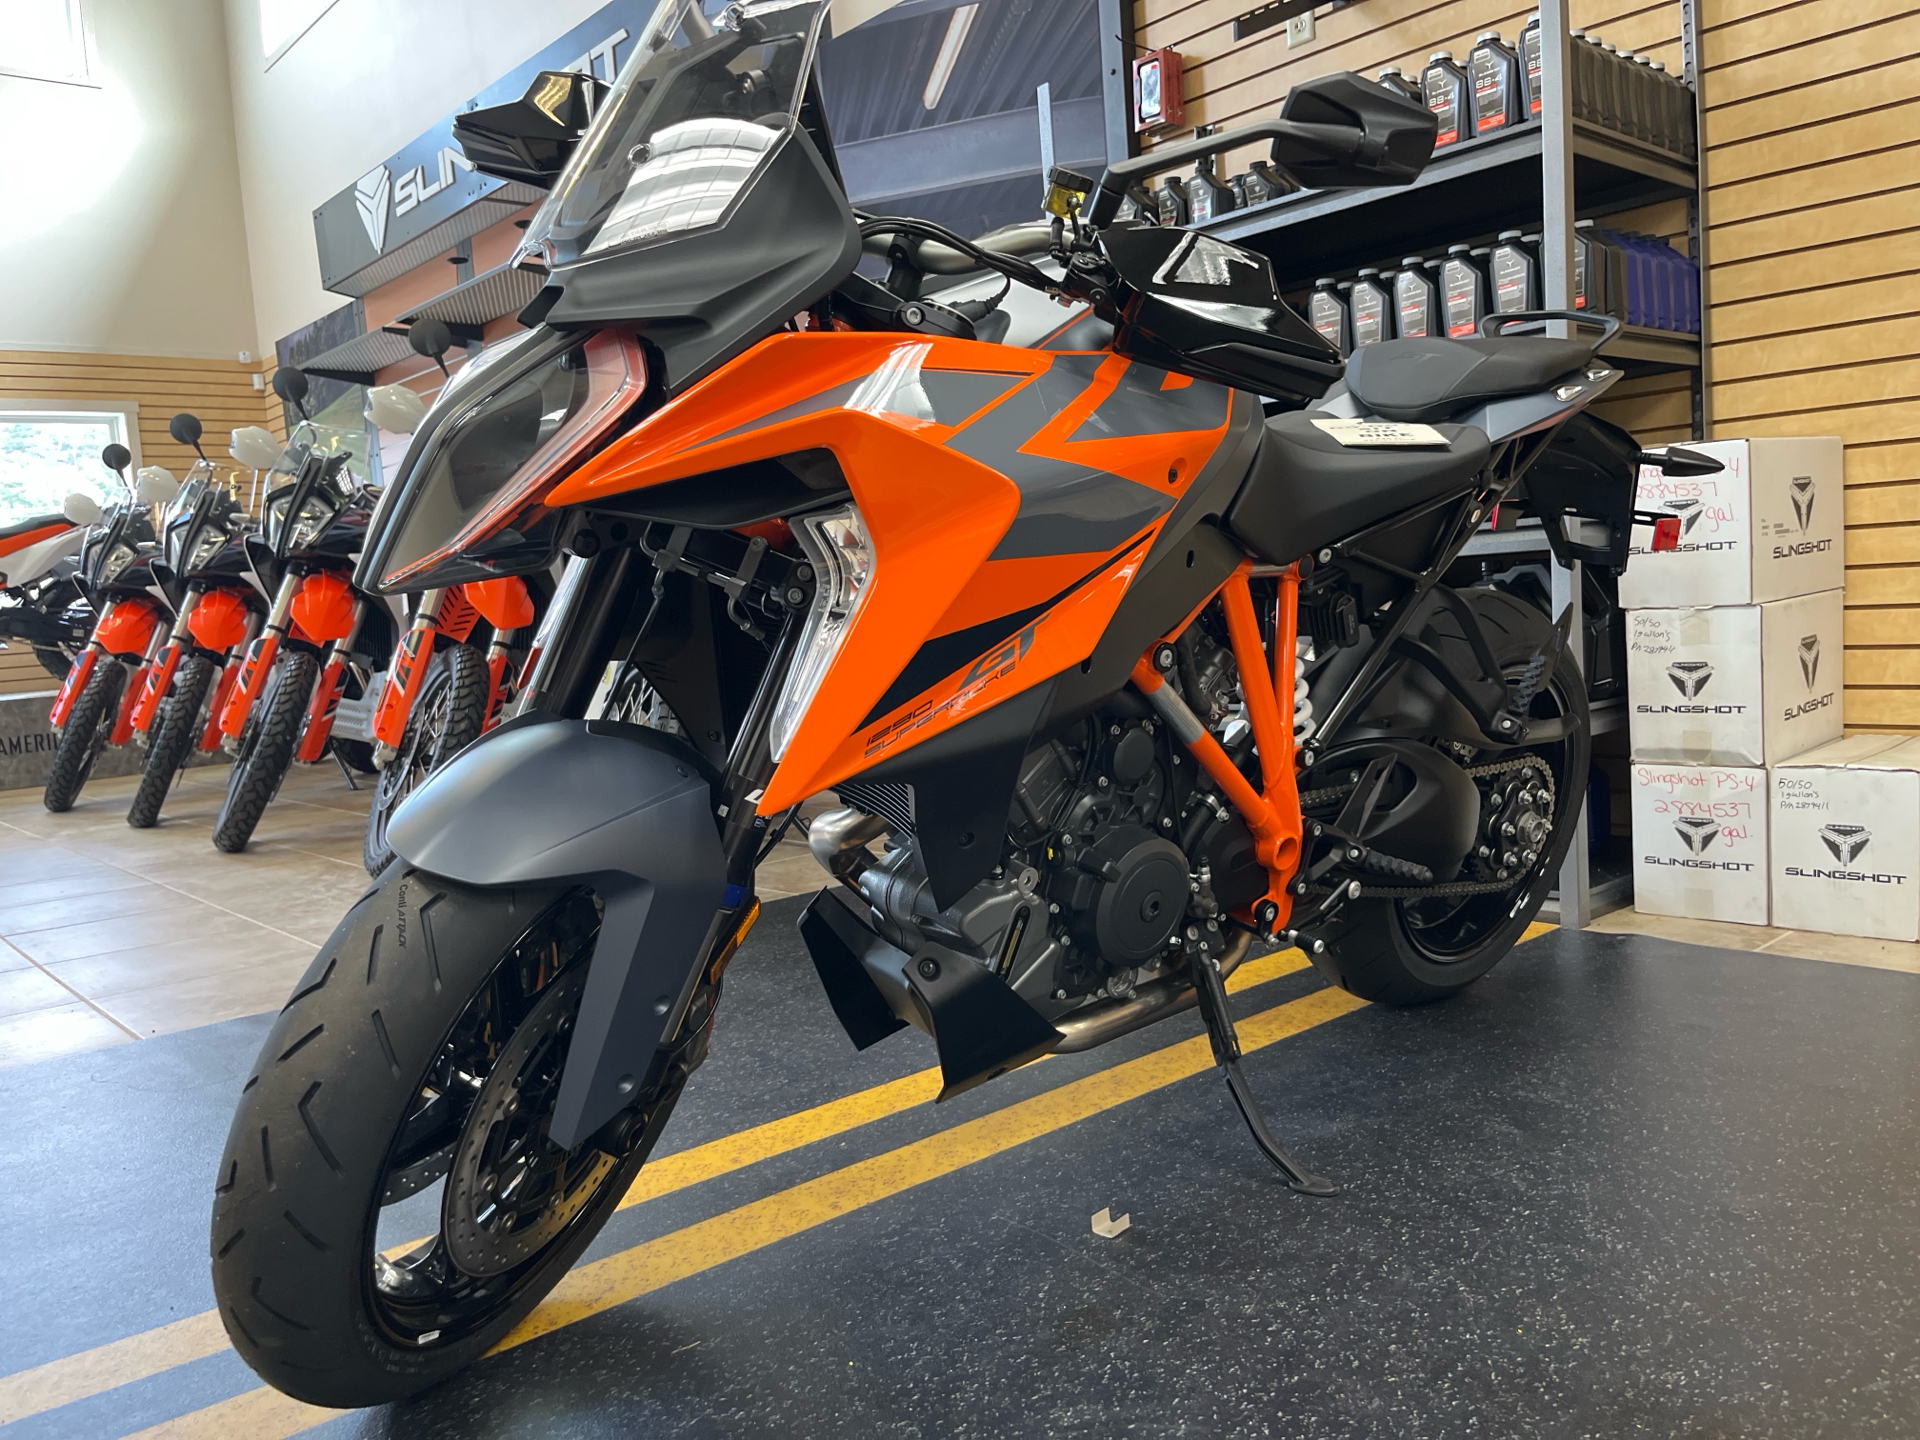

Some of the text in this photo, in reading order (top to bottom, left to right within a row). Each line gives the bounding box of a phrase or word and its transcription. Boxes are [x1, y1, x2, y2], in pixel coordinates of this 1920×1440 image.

[1773, 539, 1832, 559] SLINGSHOT
[1637, 705, 1747, 713] SLINGSHOT
[1784, 692, 1834, 721] SLINGSHOT
[866, 699, 933, 747] 1290
[1637, 767, 1754, 794] Slingshot PS-4
[1778, 777, 1813, 789] 50/50
[1654, 799, 1752, 819] 2884537
[1644, 855, 1755, 872] SLINGSHOT
[1785, 866, 1907, 885] SLINGSHOT
